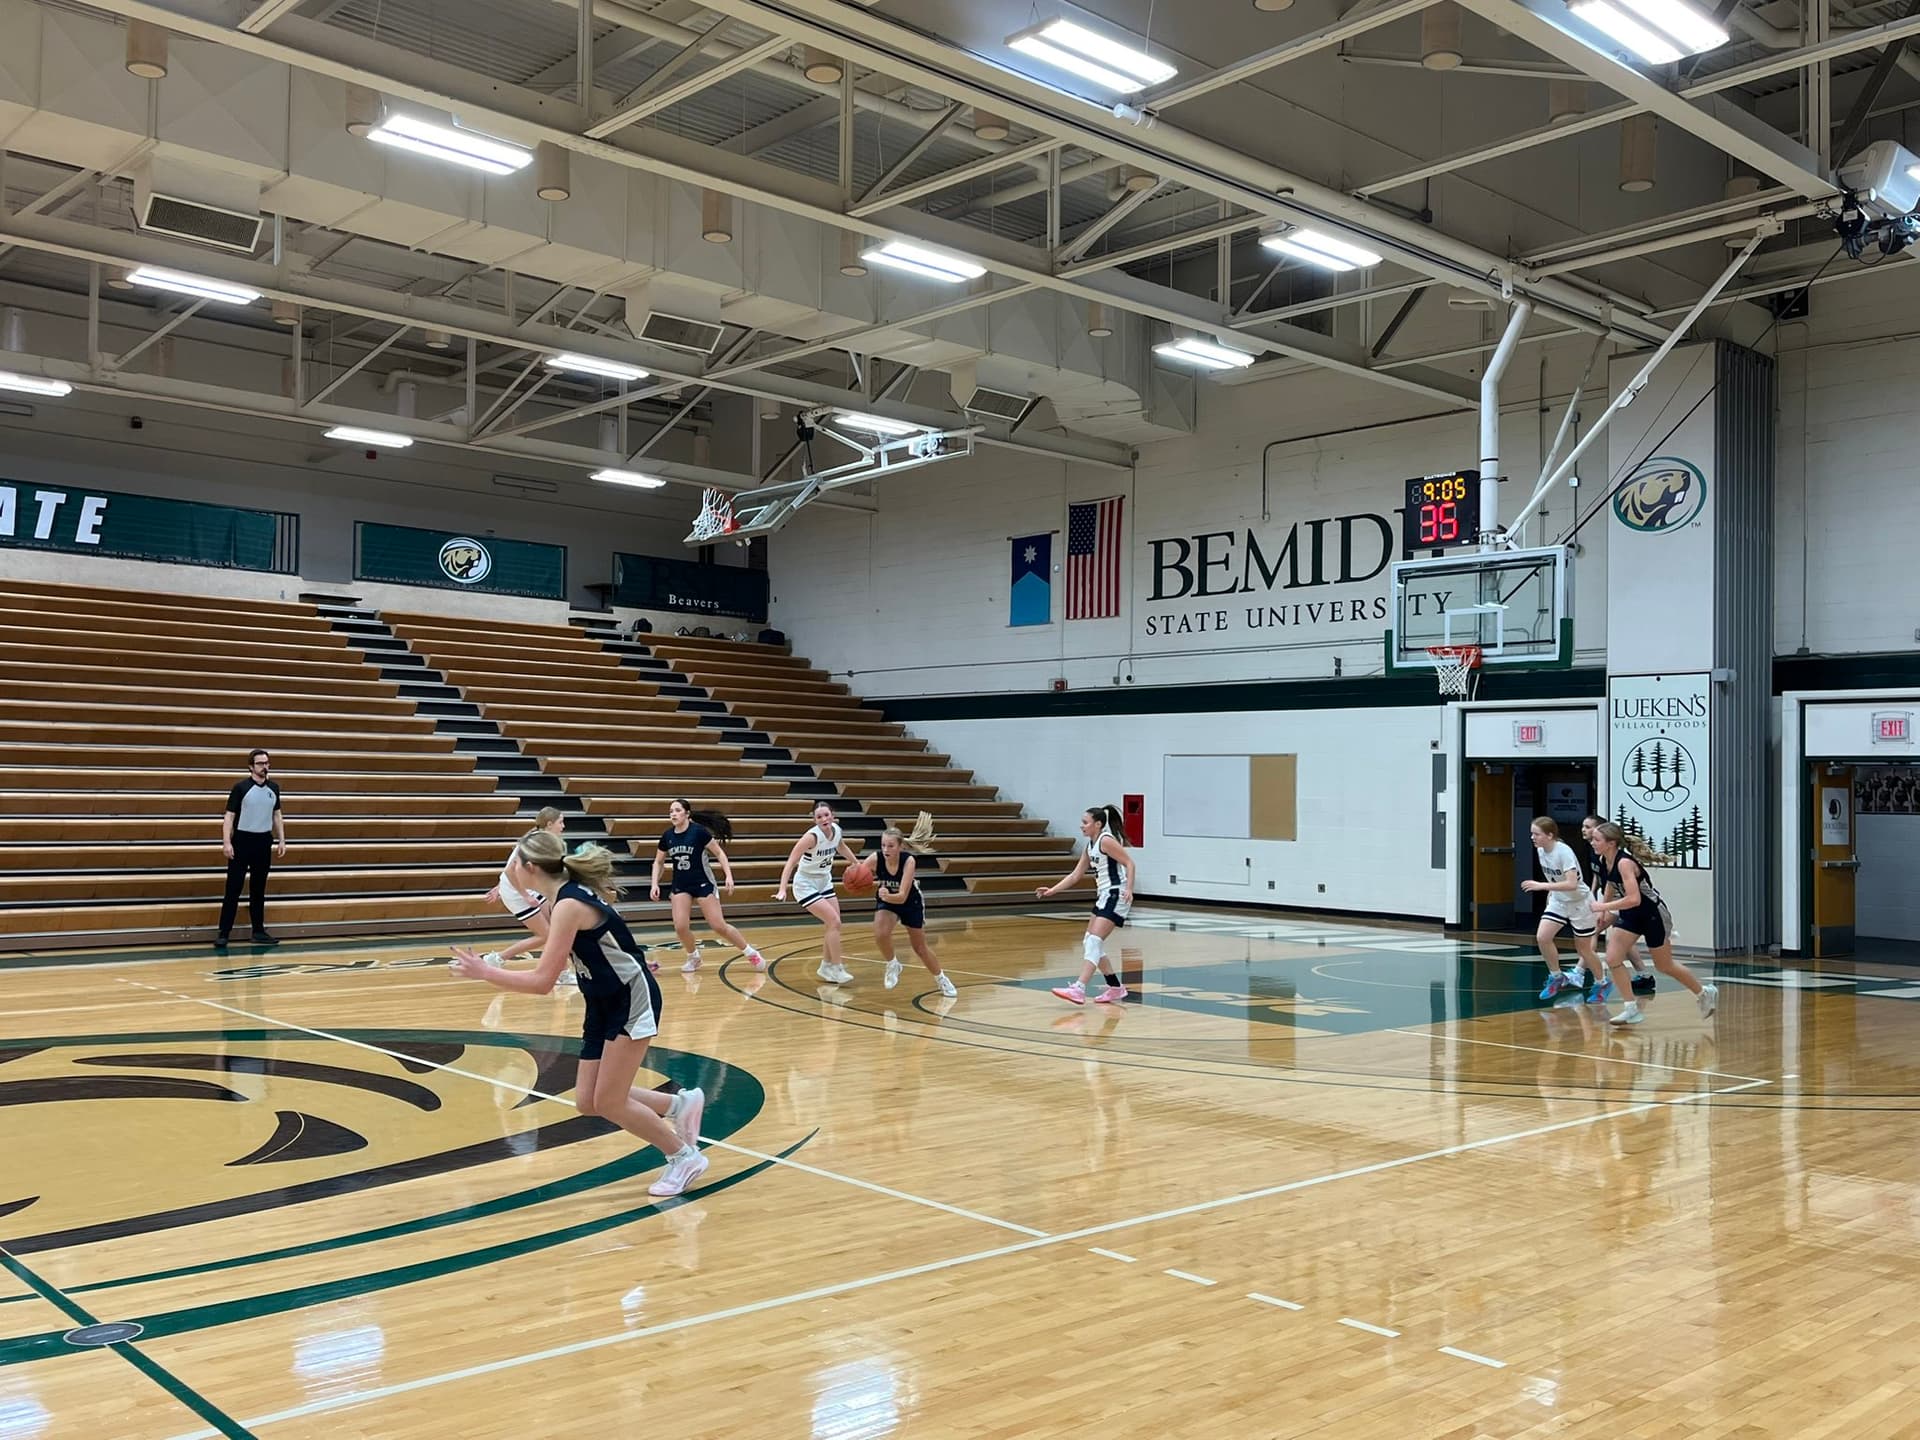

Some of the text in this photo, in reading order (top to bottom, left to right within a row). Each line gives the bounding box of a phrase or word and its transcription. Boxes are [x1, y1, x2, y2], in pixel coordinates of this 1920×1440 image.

[1423, 477, 1466, 501] 9:05
[1420, 502, 1458, 542] 35
[1146, 508, 1443, 601] BEMID
[669, 593, 720, 609] Beavers
[1146, 591, 1453, 636] STATE UNIVERSTY
[1614, 693, 1706, 718] LUEKEN'S
[1614, 720, 1707, 729] VILLAGE FOODS
[1881, 720, 1904, 737] EXIT
